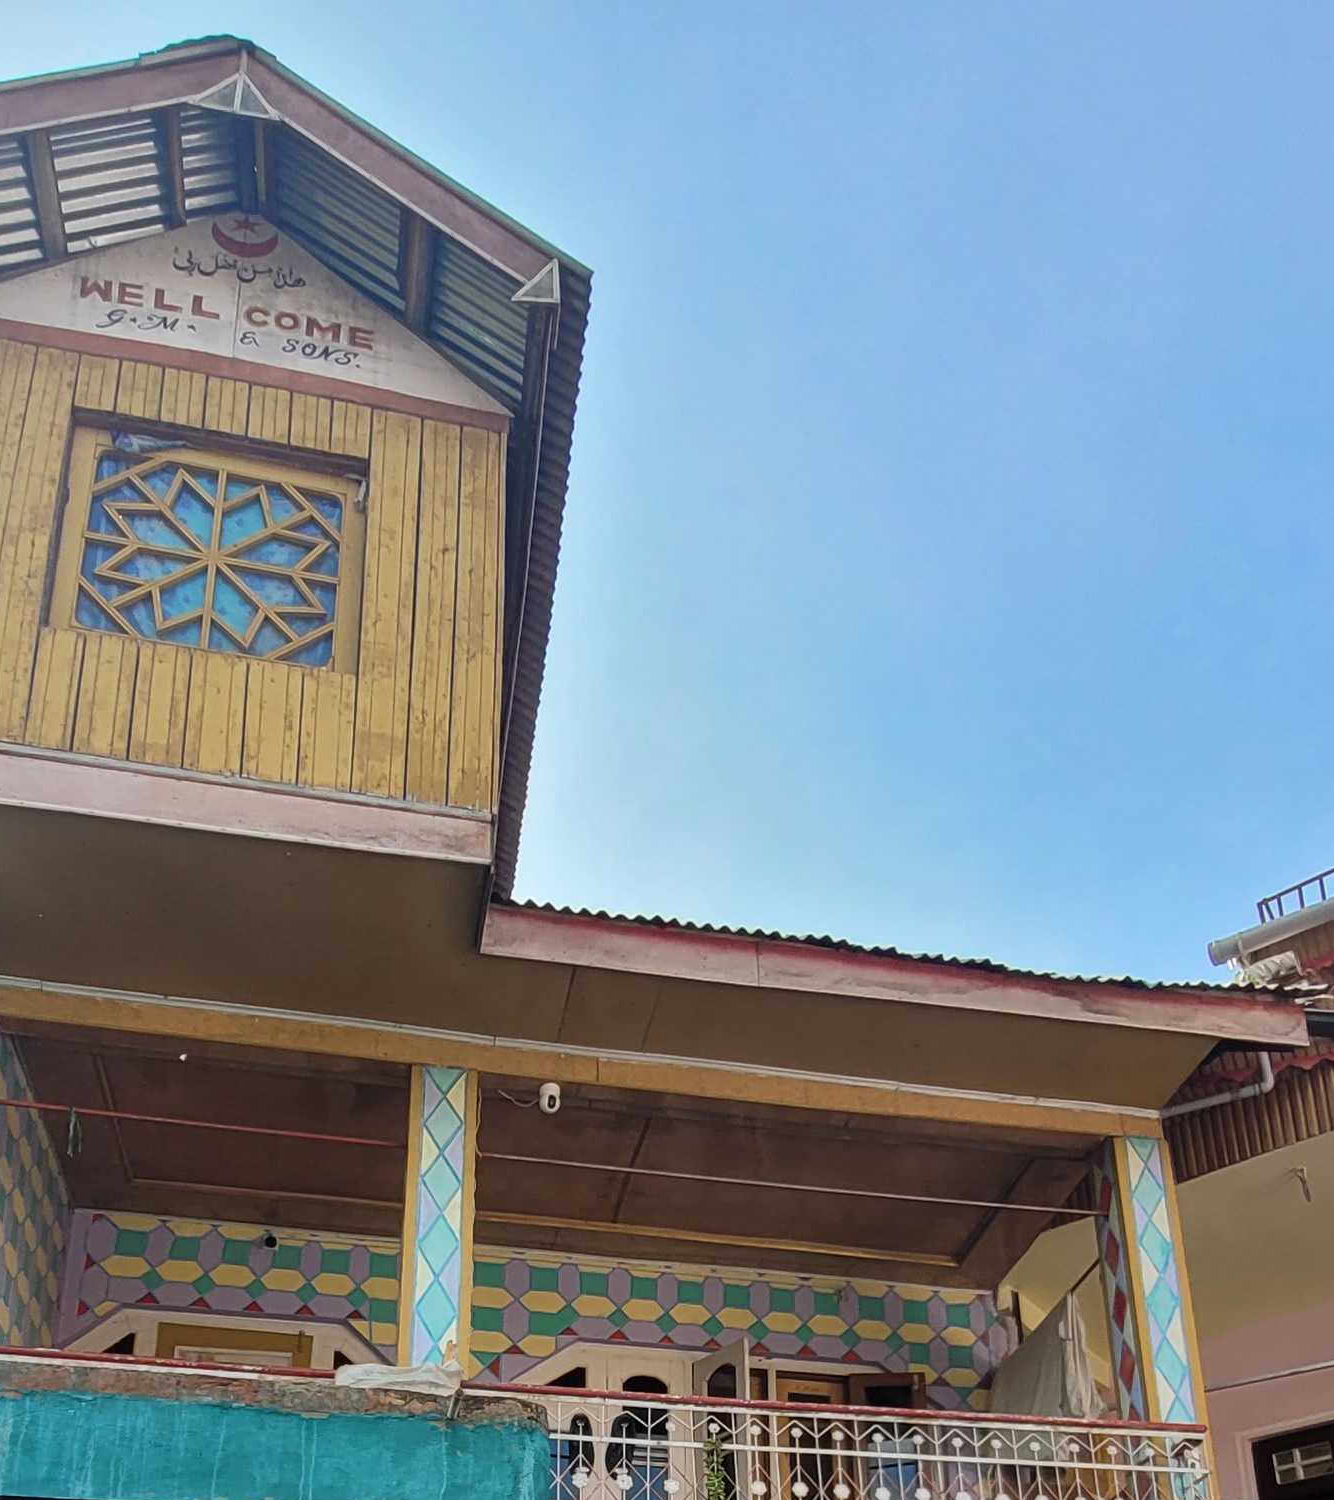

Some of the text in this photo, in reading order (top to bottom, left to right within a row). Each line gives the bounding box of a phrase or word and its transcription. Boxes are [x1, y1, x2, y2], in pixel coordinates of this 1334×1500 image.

[79, 276, 375, 350] WELL COME
[240, 331, 260, 347] &
